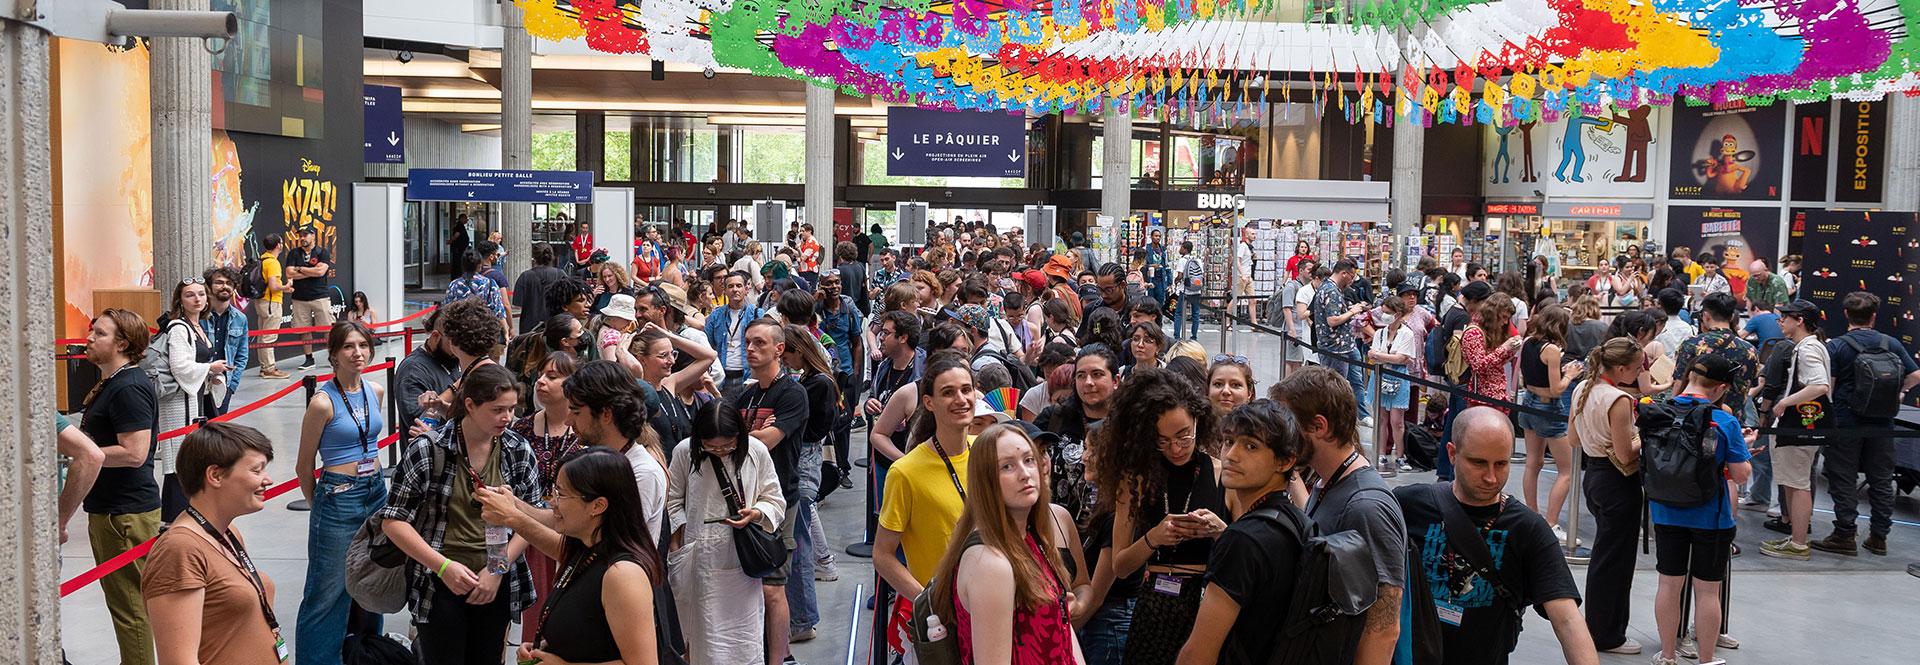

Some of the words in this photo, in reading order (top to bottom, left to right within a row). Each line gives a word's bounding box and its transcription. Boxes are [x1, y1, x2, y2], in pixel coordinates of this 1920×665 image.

[913, 134, 929, 144] LE
[936, 132, 1000, 146] PÂQUIER
[1801, 116, 1823, 156] N
[1854, 100, 1870, 190] EXPOSITIO
[301, 158, 321, 176] Disney
[282, 177, 337, 227] KIZAZI
[1570, 206, 1620, 216] CARTERIE
